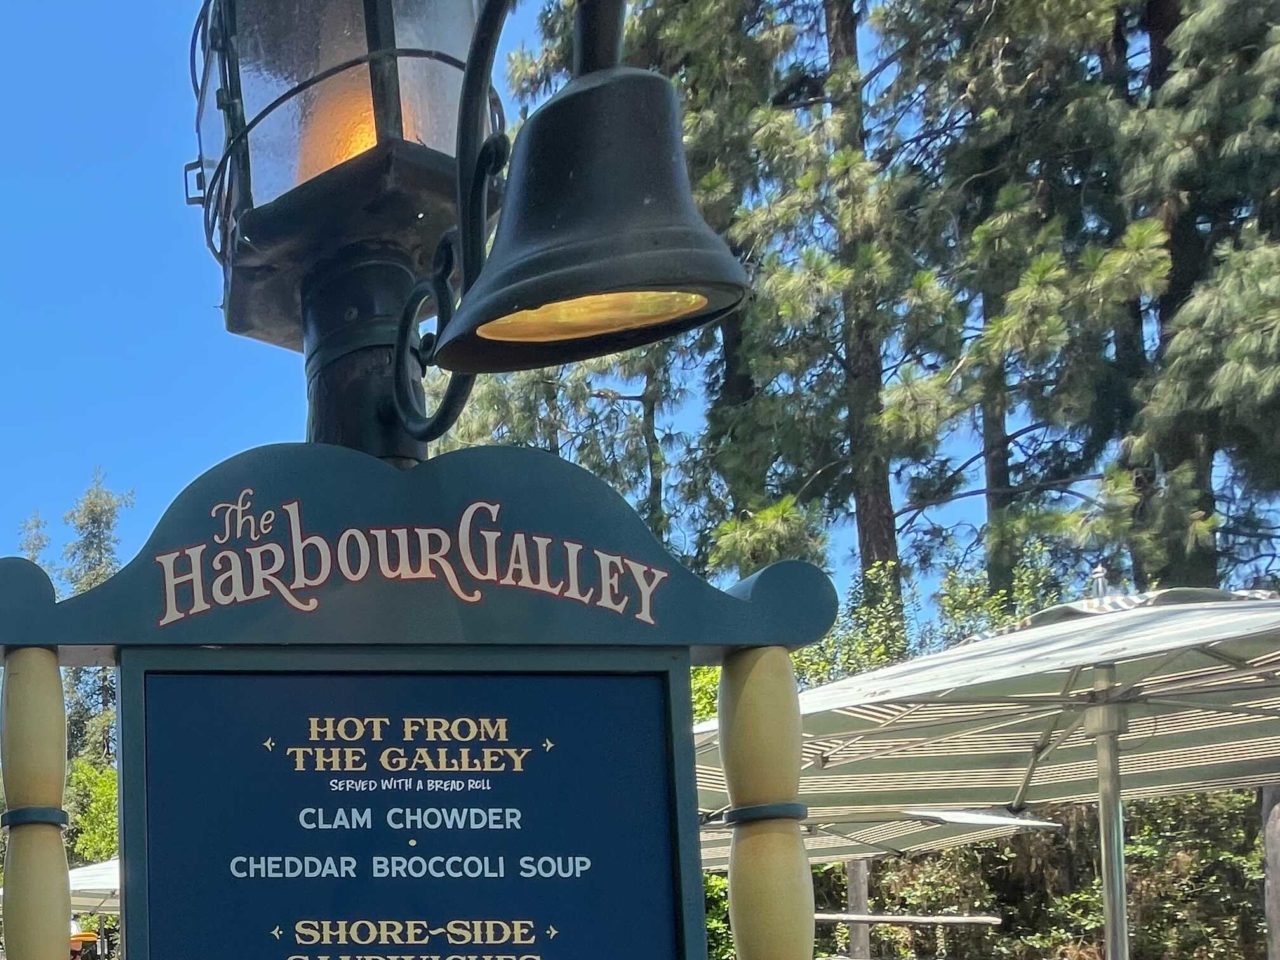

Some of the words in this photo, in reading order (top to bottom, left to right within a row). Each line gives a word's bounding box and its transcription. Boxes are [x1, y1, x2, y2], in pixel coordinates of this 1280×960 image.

[211, 488, 275, 544] The
[308, 717, 390, 741] HOT
[402, 718, 509, 741] FROM
[286, 747, 367, 771] THE
[379, 747, 532, 771] GALLEY
[329, 779, 377, 791] SERVED
[381, 777, 413, 790] WITH
[416, 779, 424, 791] A
[427, 779, 465, 791] BREAD
[468, 778, 492, 790] ROLL
[298, 808, 372, 829] CLAM
[386, 808, 522, 829] CHOWDER
[229, 856, 356, 878] CHEDDAR
[372, 856, 505, 878] BROCCOLI
[519, 856, 591, 878] SOUP
